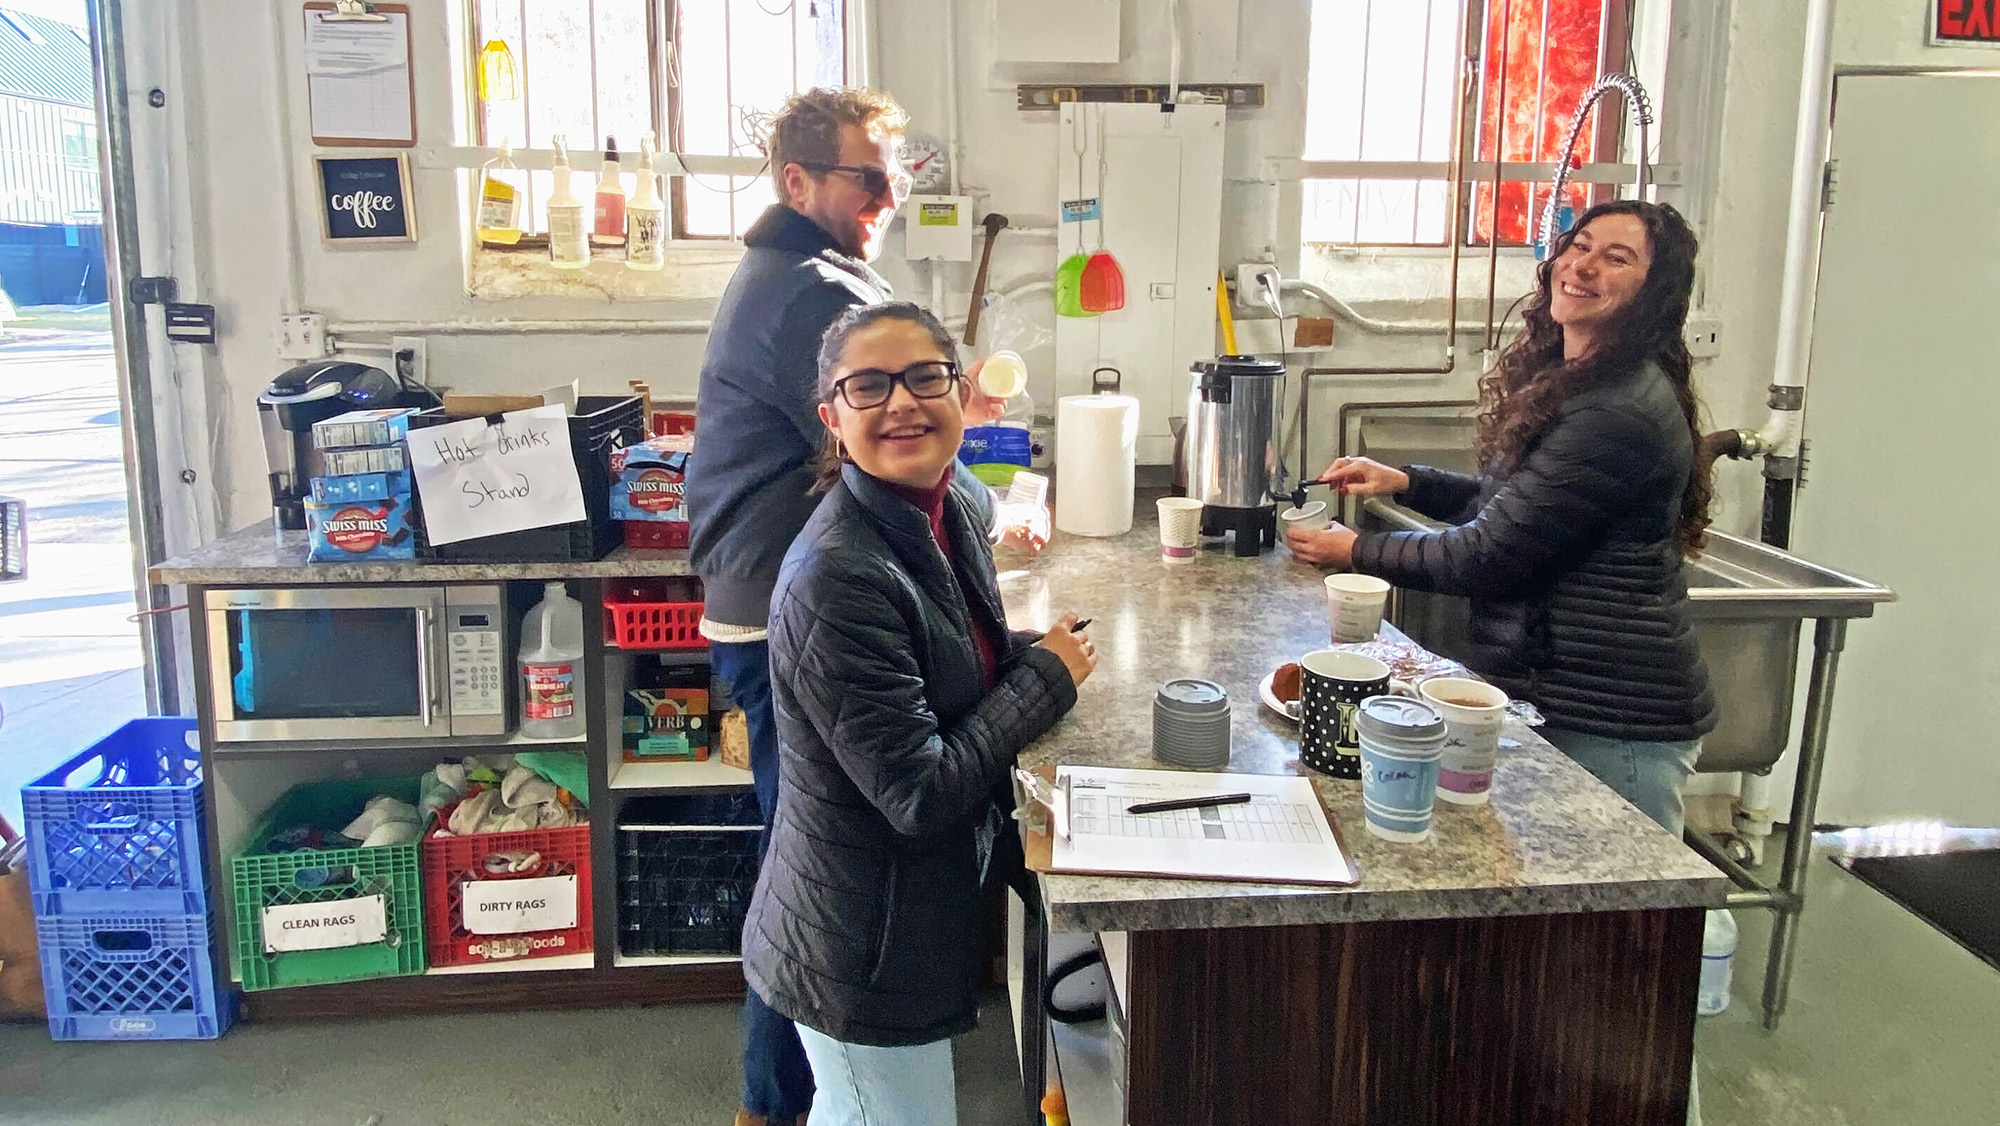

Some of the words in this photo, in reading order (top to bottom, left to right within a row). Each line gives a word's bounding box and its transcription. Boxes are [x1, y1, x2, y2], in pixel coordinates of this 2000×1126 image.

[331, 191, 395, 228] coffee
[434, 437, 478, 464] Hot
[611, 458, 624, 469] 50
[462, 472, 530, 508] Stand
[627, 480, 657, 494] SWISS
[659, 481, 685, 495] MISS
[322, 519, 357, 534] SWISS
[358, 518, 388, 532] MISS
[645, 715, 685, 730] VERB
[480, 902, 513, 912] DIRTY
[515, 899, 546, 910] RAGS
[282, 917, 320, 930] CLEAN
[323, 914, 356, 927] RAGS
